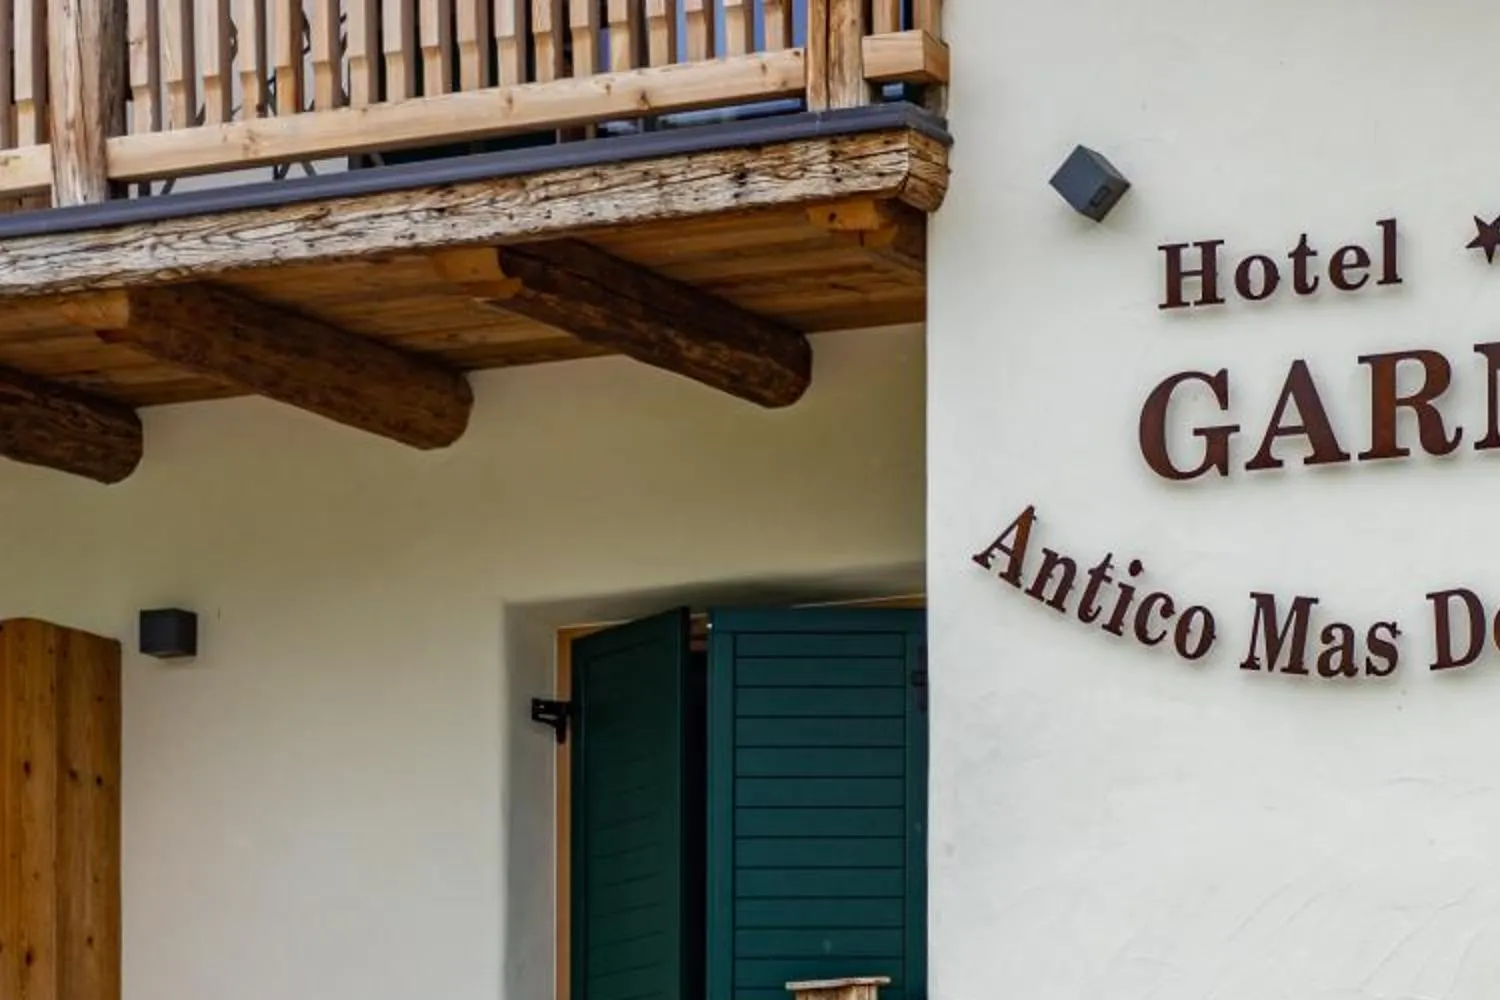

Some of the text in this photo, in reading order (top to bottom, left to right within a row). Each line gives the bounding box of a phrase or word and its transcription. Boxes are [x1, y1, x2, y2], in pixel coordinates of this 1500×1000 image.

[1158, 219, 1403, 309] Hotel
[972, 505, 1217, 662] Antico
[1239, 591, 1402, 679] Mas
